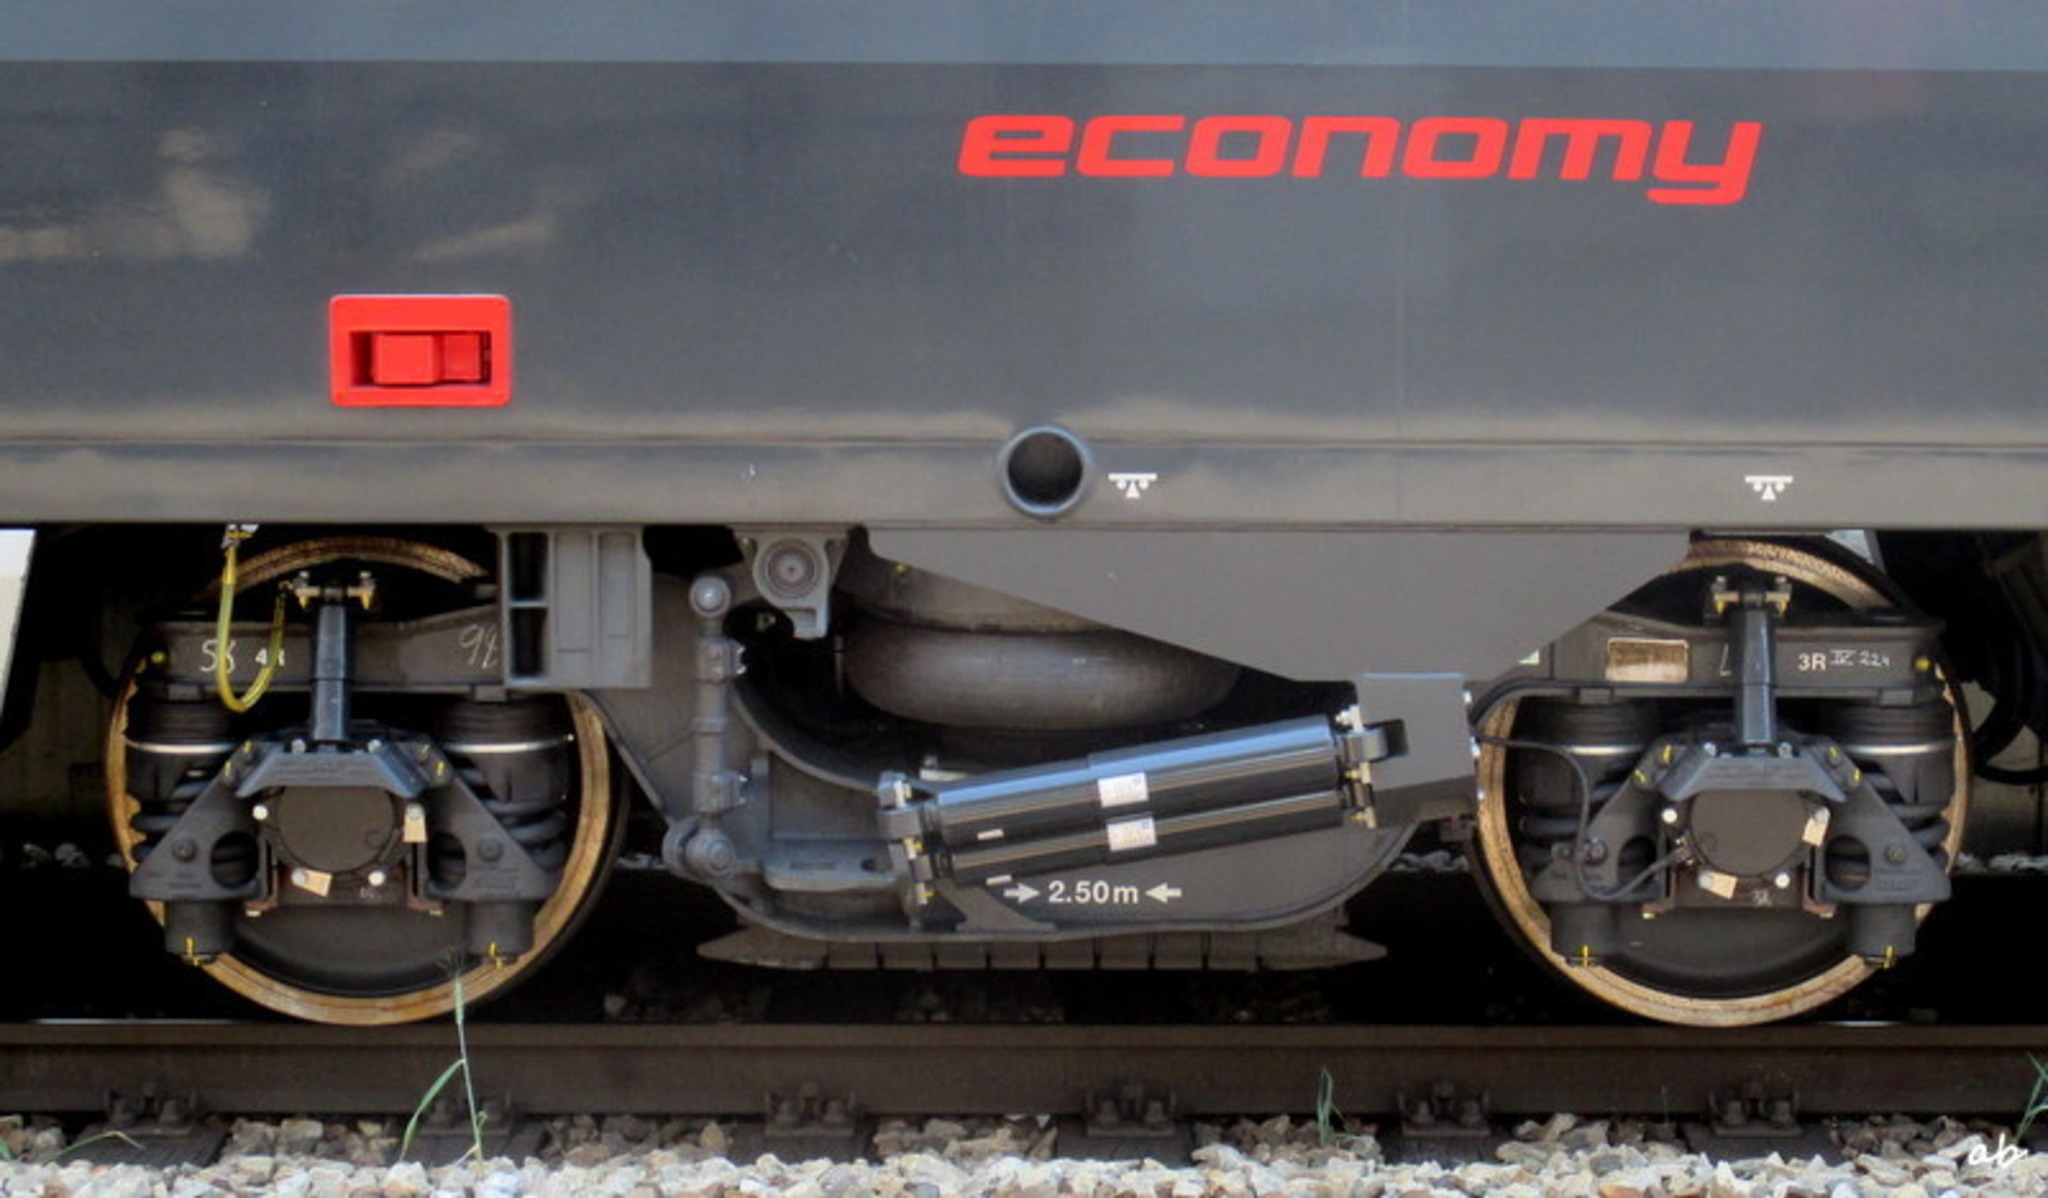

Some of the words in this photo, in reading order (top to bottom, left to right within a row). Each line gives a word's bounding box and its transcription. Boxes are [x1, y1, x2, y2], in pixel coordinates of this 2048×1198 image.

[957, 114, 1762, 205] economy
[1798, 652, 1827, 672] 3R
[1048, 880, 1139, 904] 2.50m
